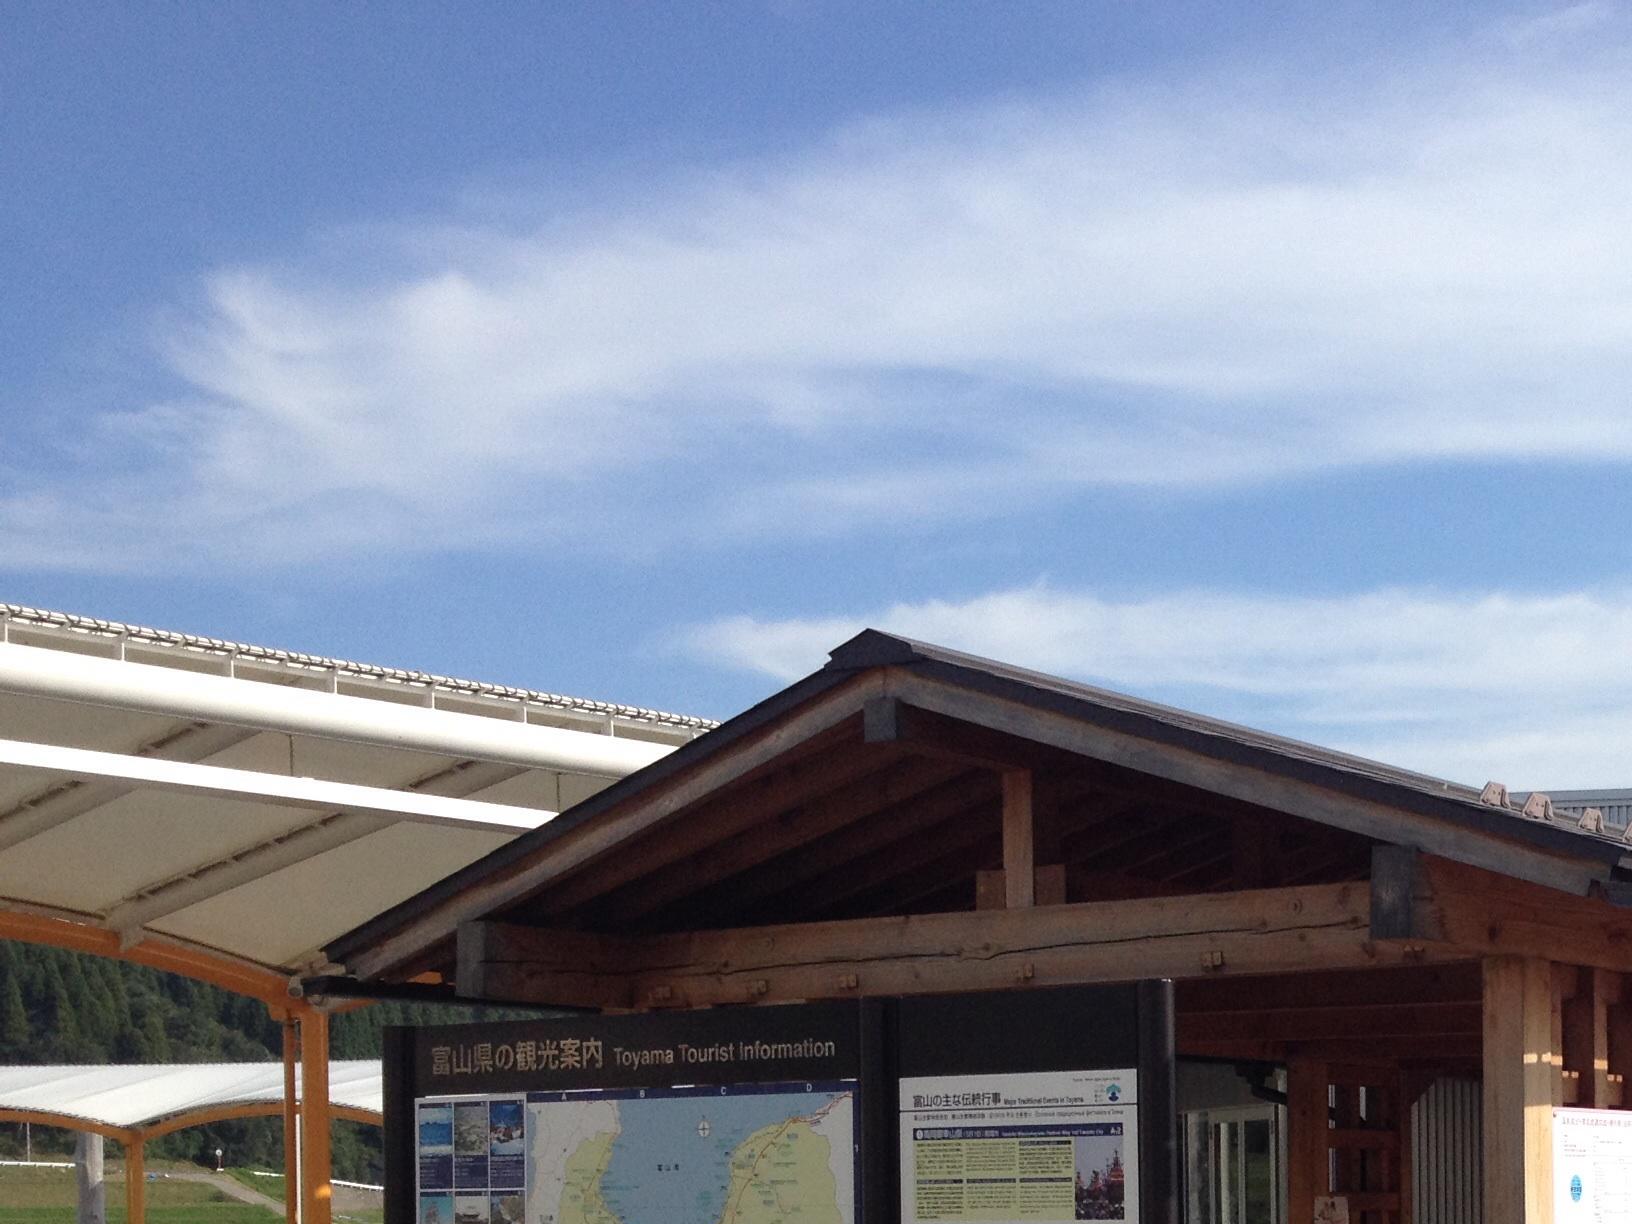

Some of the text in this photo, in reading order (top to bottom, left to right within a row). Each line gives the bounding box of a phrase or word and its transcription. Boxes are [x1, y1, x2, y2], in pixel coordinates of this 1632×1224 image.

[431, 1038, 602, 1076] 富山県の観光案内
[613, 1038, 836, 1072] Toyama Tourist Information
